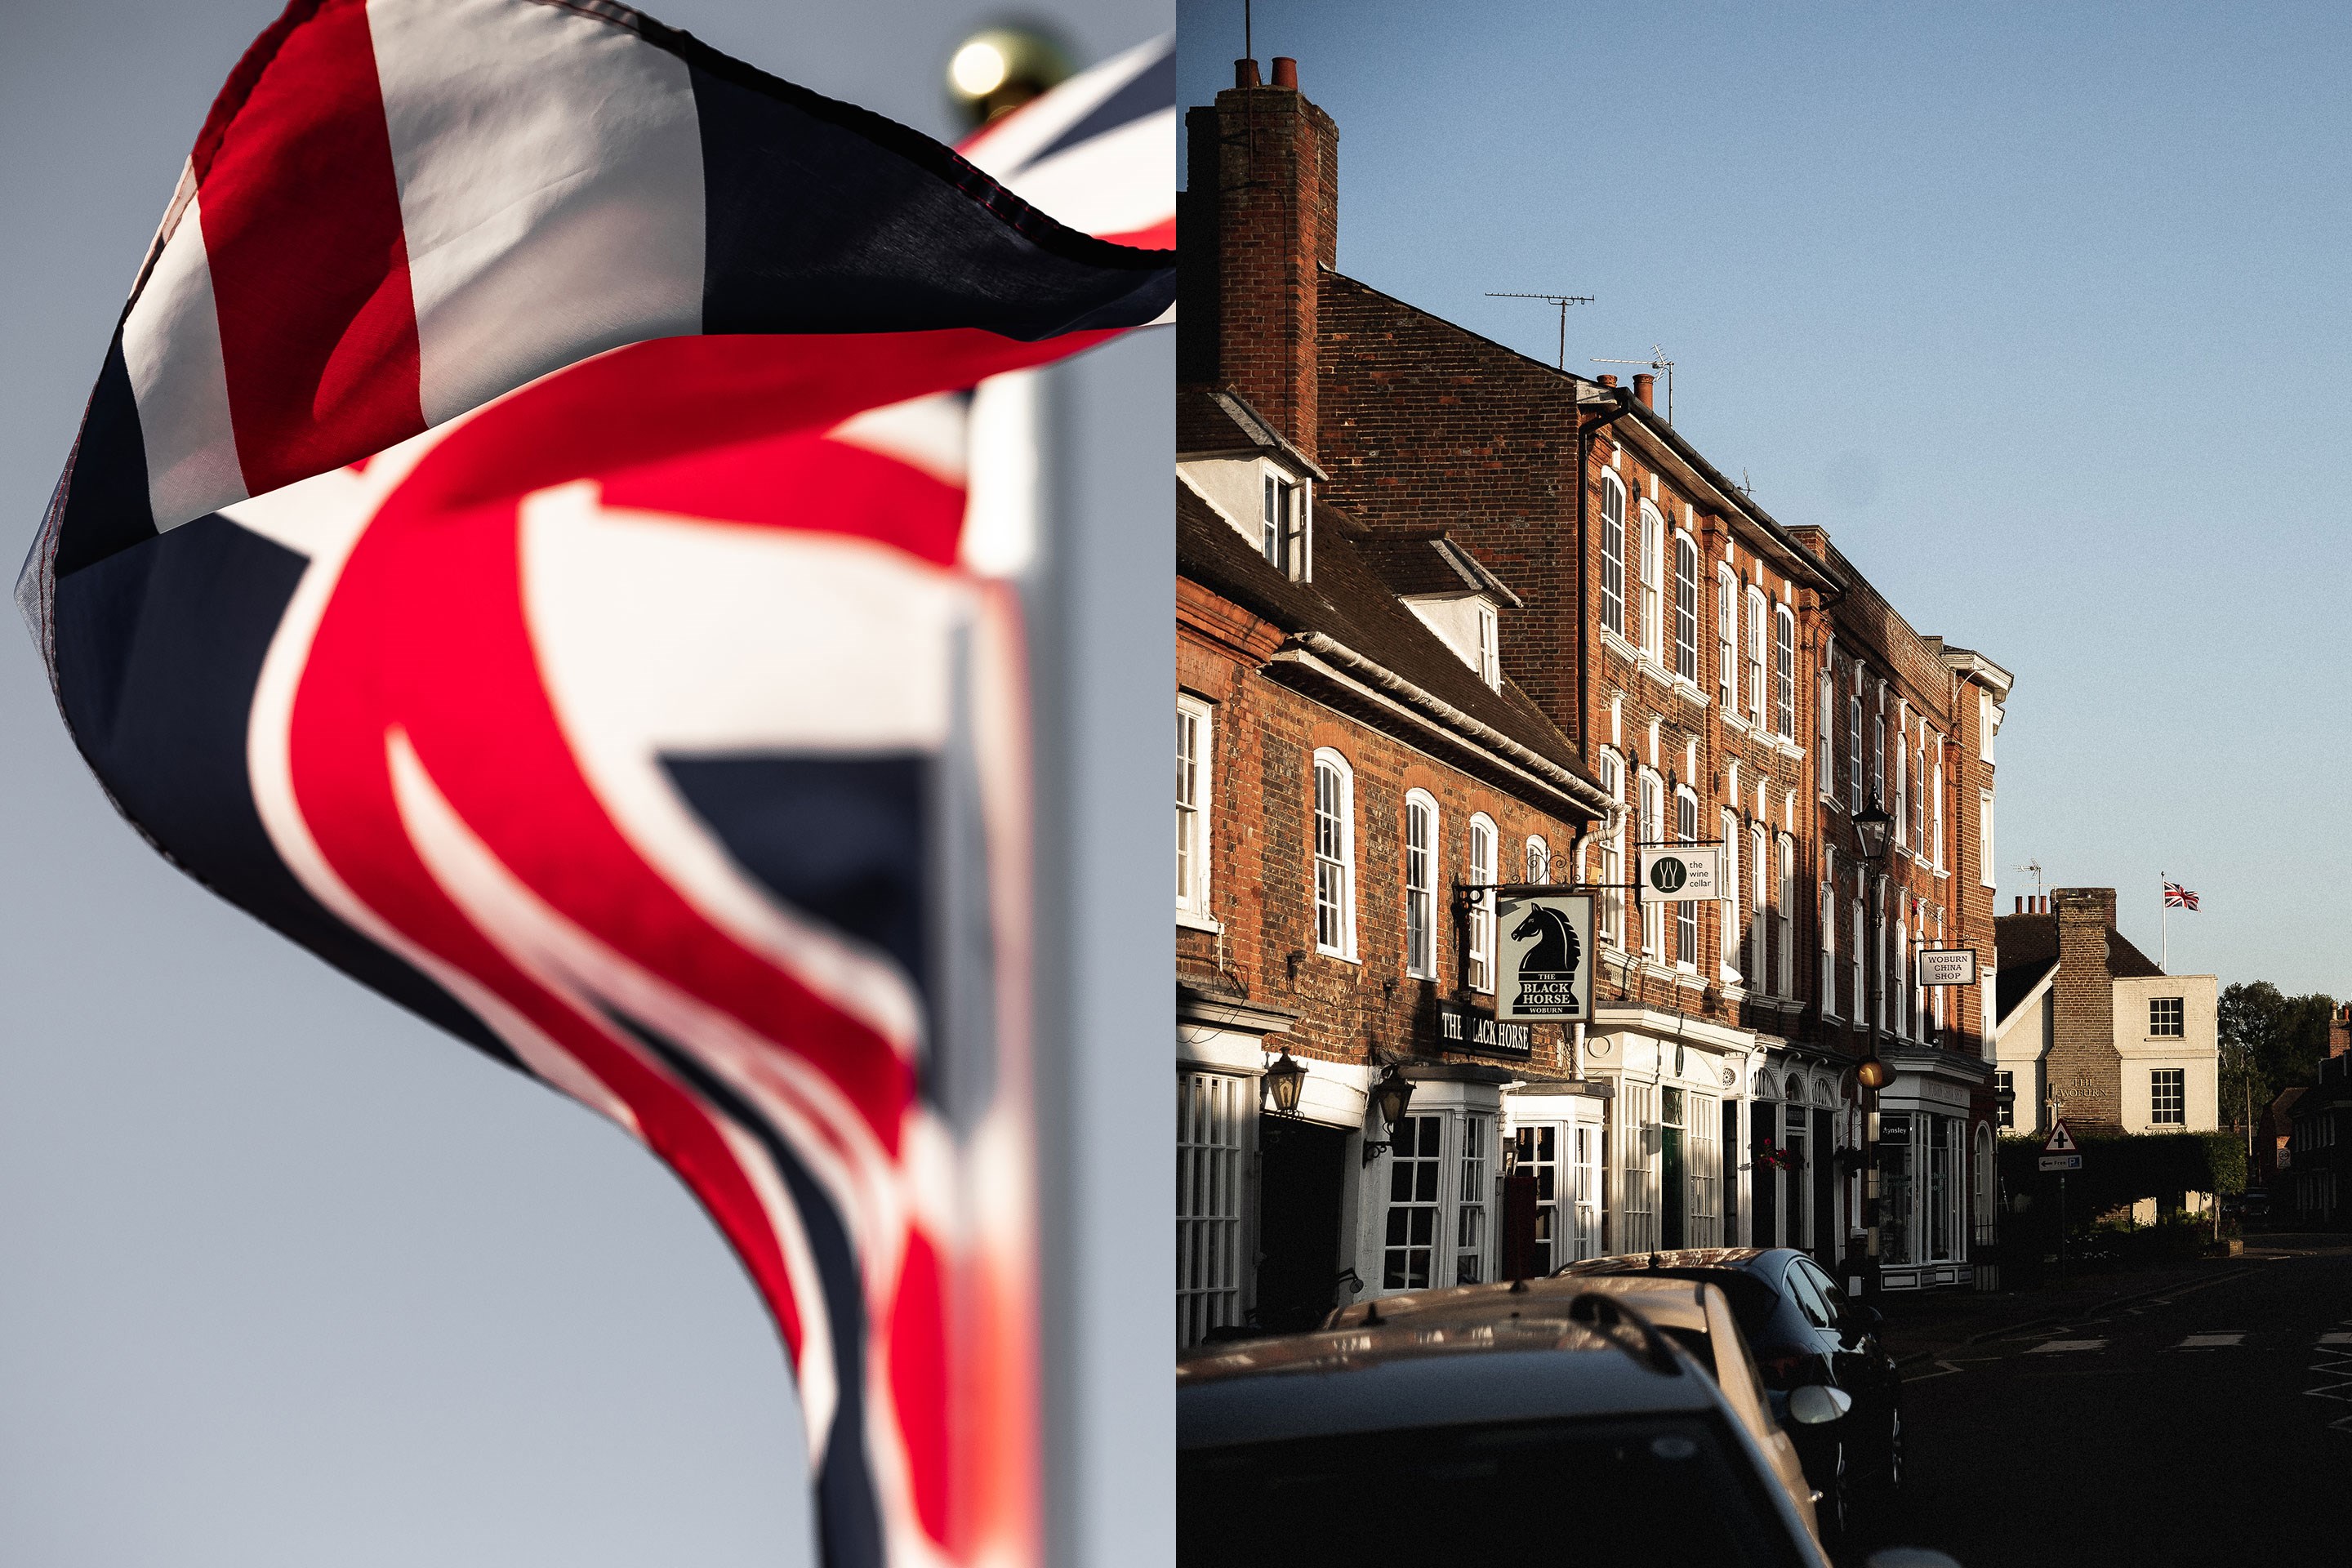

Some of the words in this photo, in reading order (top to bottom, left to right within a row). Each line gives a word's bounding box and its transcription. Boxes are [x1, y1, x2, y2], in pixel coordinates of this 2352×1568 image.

[1689, 861, 1703, 869] the
[1689, 870, 1709, 878] wine
[1689, 879, 1712, 888] cellar
[1523, 982, 1569, 993] BLACK
[1523, 994, 1570, 1004] HORSE
[1441, 1012, 1463, 1040] THE
[1498, 1023, 1529, 1050] HORSE
[2057, 1089, 2106, 1097] WOBURN
[1882, 1127, 1907, 1135] Aynsley
[2069, 1158, 2076, 1167] P
